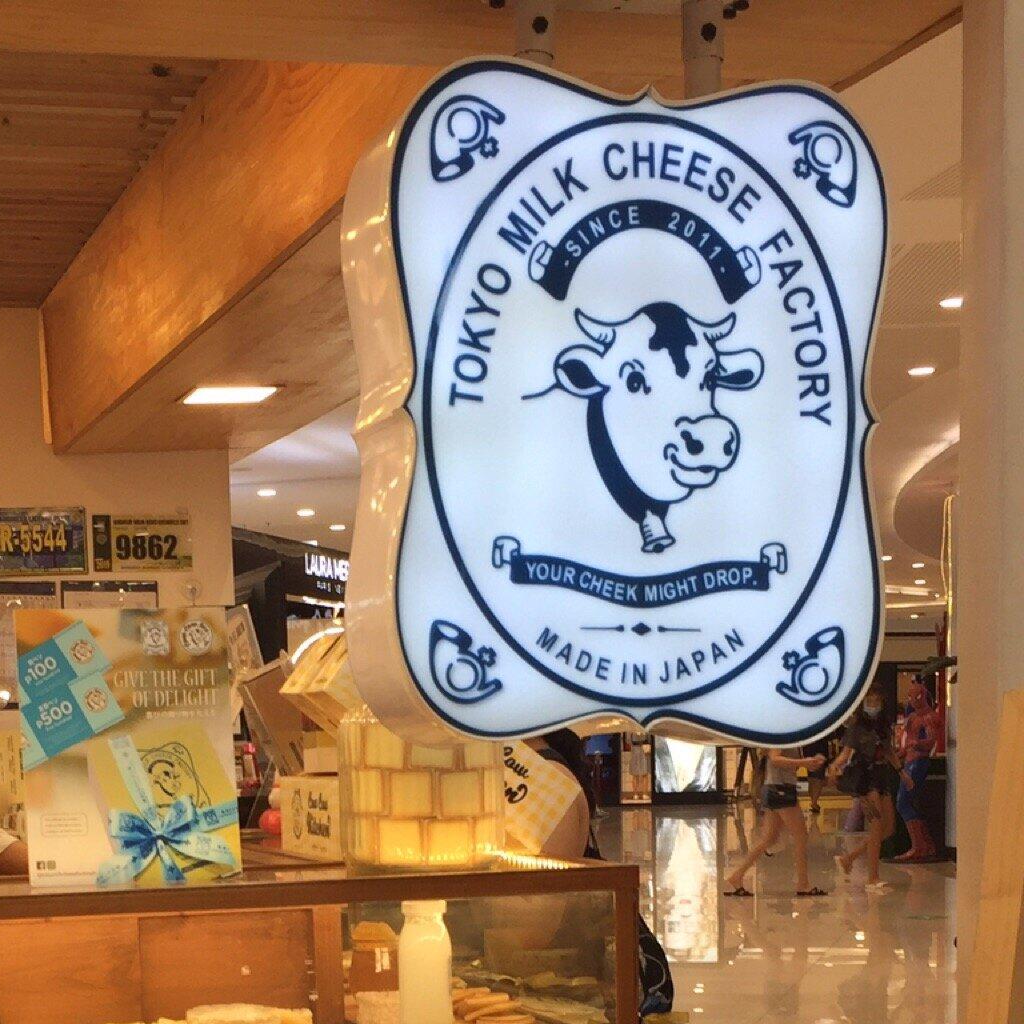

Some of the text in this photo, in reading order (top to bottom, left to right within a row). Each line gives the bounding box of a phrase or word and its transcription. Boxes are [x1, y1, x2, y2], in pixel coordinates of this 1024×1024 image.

[566, 207, 723, 262] SINCE 2011
[449, 141, 832, 427] TOKYO MILK CHEESE FACTORY
[116, 534, 178, 560] 9862
[527, 560, 758, 601] YOUR CHEEK MIGHT DROP.
[536, 626, 745, 684] MADE IN JAPAN
